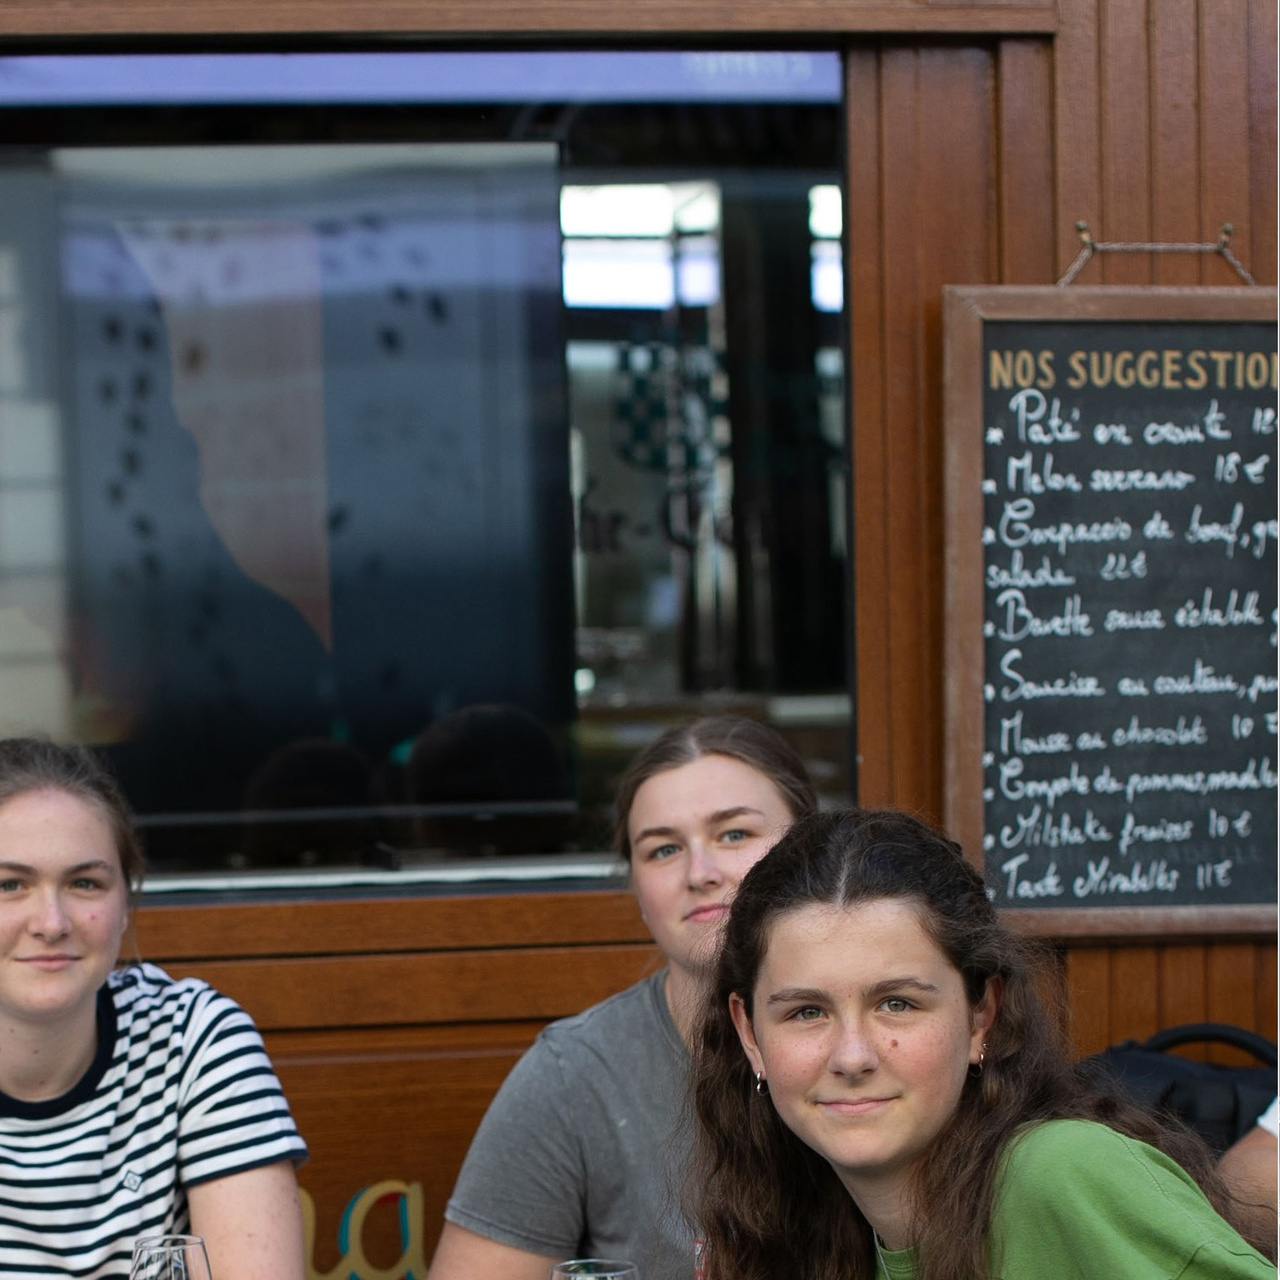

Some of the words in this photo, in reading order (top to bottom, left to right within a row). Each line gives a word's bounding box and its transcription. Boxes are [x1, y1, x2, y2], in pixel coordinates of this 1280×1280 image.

[989, 350, 1056, 389] NOS
[1093, 422, 1132, 445] en
[1007, 450, 1083, 494] Melon
[1089, 469, 1196, 491] serrano
[1143, 509, 1174, 539] de
[985, 548, 1076, 589] salade
[996, 587, 1095, 642] Bavette
[1104, 609, 1166, 632] sauce
[1117, 677, 1149, 696] au
[1000, 709, 1072, 755] Mousse
[1076, 732, 1107, 750] au
[1112, 714, 1208, 747] chocolat
[999, 756, 1090, 809] Compote
[1093, 765, 1125, 794] de
[1001, 852, 1064, 899] Tarte
